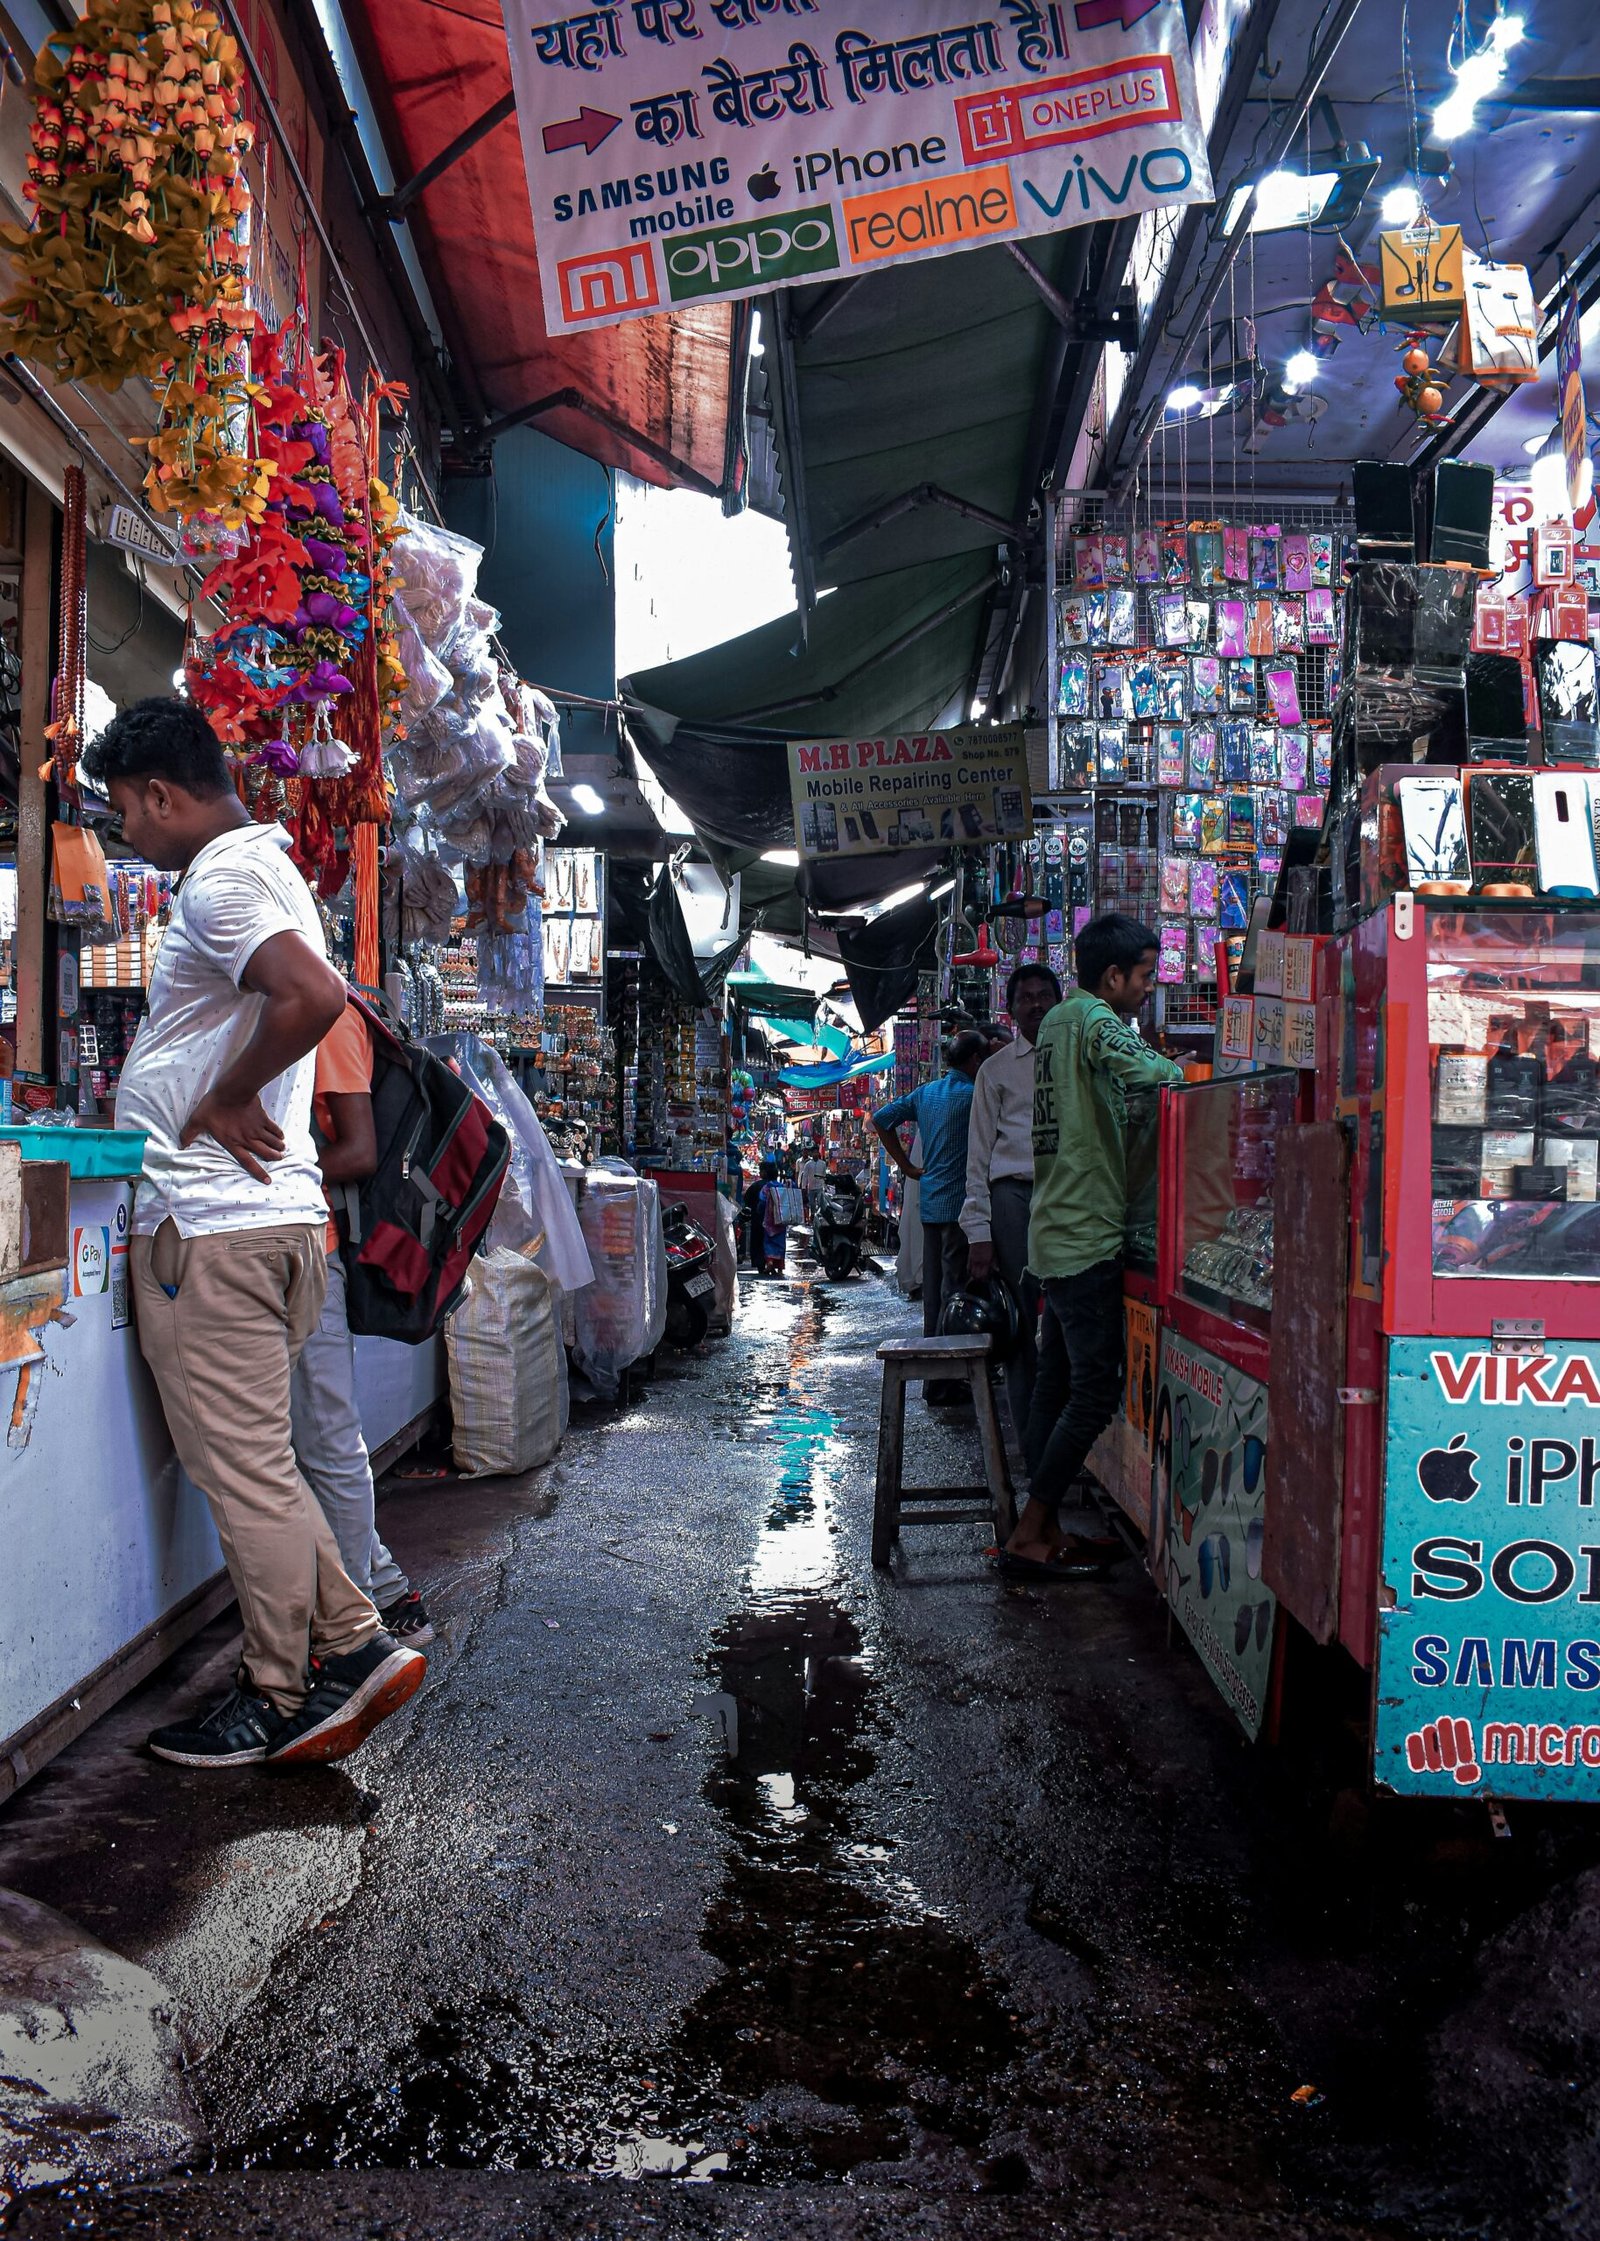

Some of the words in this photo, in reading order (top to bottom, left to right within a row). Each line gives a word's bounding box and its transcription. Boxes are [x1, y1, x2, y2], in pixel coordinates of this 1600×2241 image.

[632, 0, 703, 45] पर
[630, 90, 705, 147] का
[701, 42, 833, 128] बैटरी
[836, 26, 1003, 103] मिलता
[1033, 79, 1156, 126] ONEPLUS
[792, 136, 946, 191] iPhone
[1022, 148, 1192, 217] vivo
[553, 156, 730, 222] SAMSUNG
[629, 195, 734, 238] mobile
[850, 185, 1008, 255] realme
[670, 218, 831, 283] oppo
[798, 744, 850, 772] M.H
[856, 735, 953, 769] PLAZA
[962, 750, 985, 761] Shop
[807, 778, 863, 798] Mobile
[869, 772, 950, 793] Repairing
[957, 766, 1013, 785] Center
[851, 801, 863, 811] All
[867, 798, 919, 811] Accessories
[923, 793, 961, 805] Available
[964, 791, 985, 801] Here
[90, 1245, 101, 1265] Pay
[1136, 1310, 1154, 1335] TITAN
[1164, 1343, 1189, 1386] VIKASH
[1191, 1359, 1224, 1406] MOBILE
